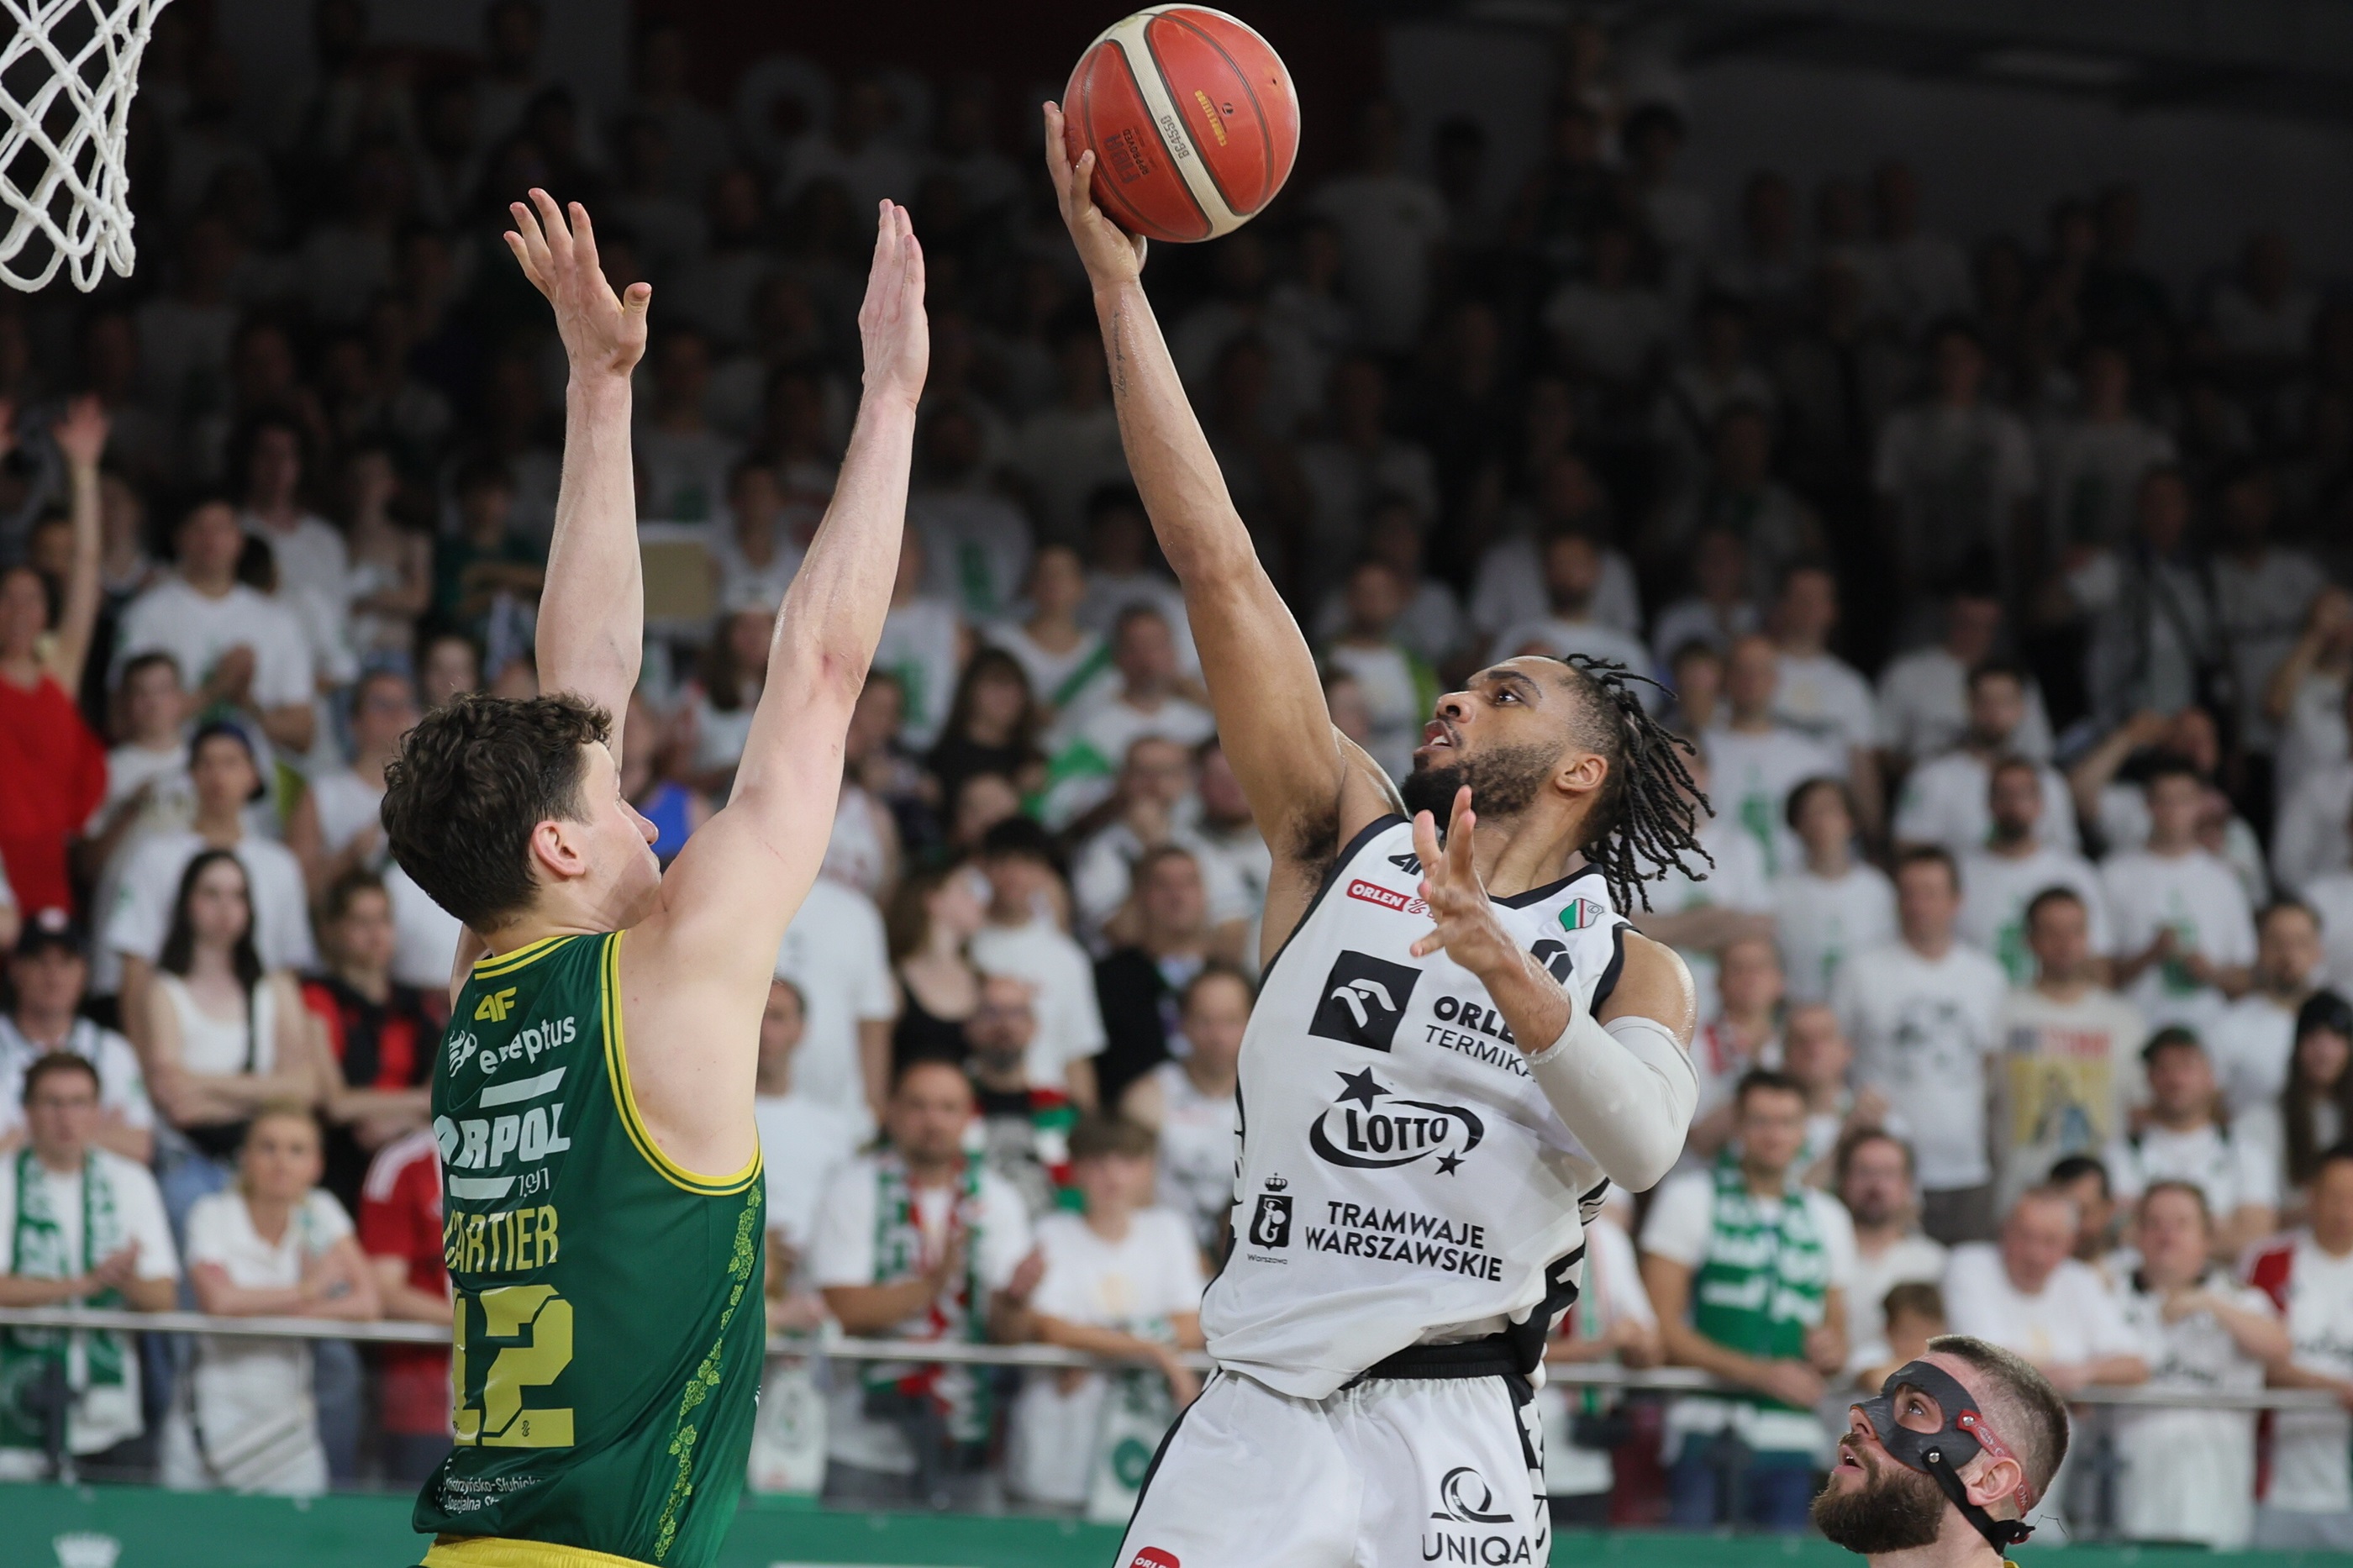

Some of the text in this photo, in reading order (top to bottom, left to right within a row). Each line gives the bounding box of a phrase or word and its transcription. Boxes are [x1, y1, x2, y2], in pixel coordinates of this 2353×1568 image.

[1123, 129, 1150, 176] APPROVED
[1351, 883, 1404, 907] ORLEN
[474, 987, 518, 1023] 4F
[1346, 1108, 1449, 1153] LOTTO
[1328, 1201, 1485, 1250] TRAMWAJE
[1305, 1226, 1503, 1282] WARSZAWSKIE
[1422, 1532, 1532, 1566] UNIQA
